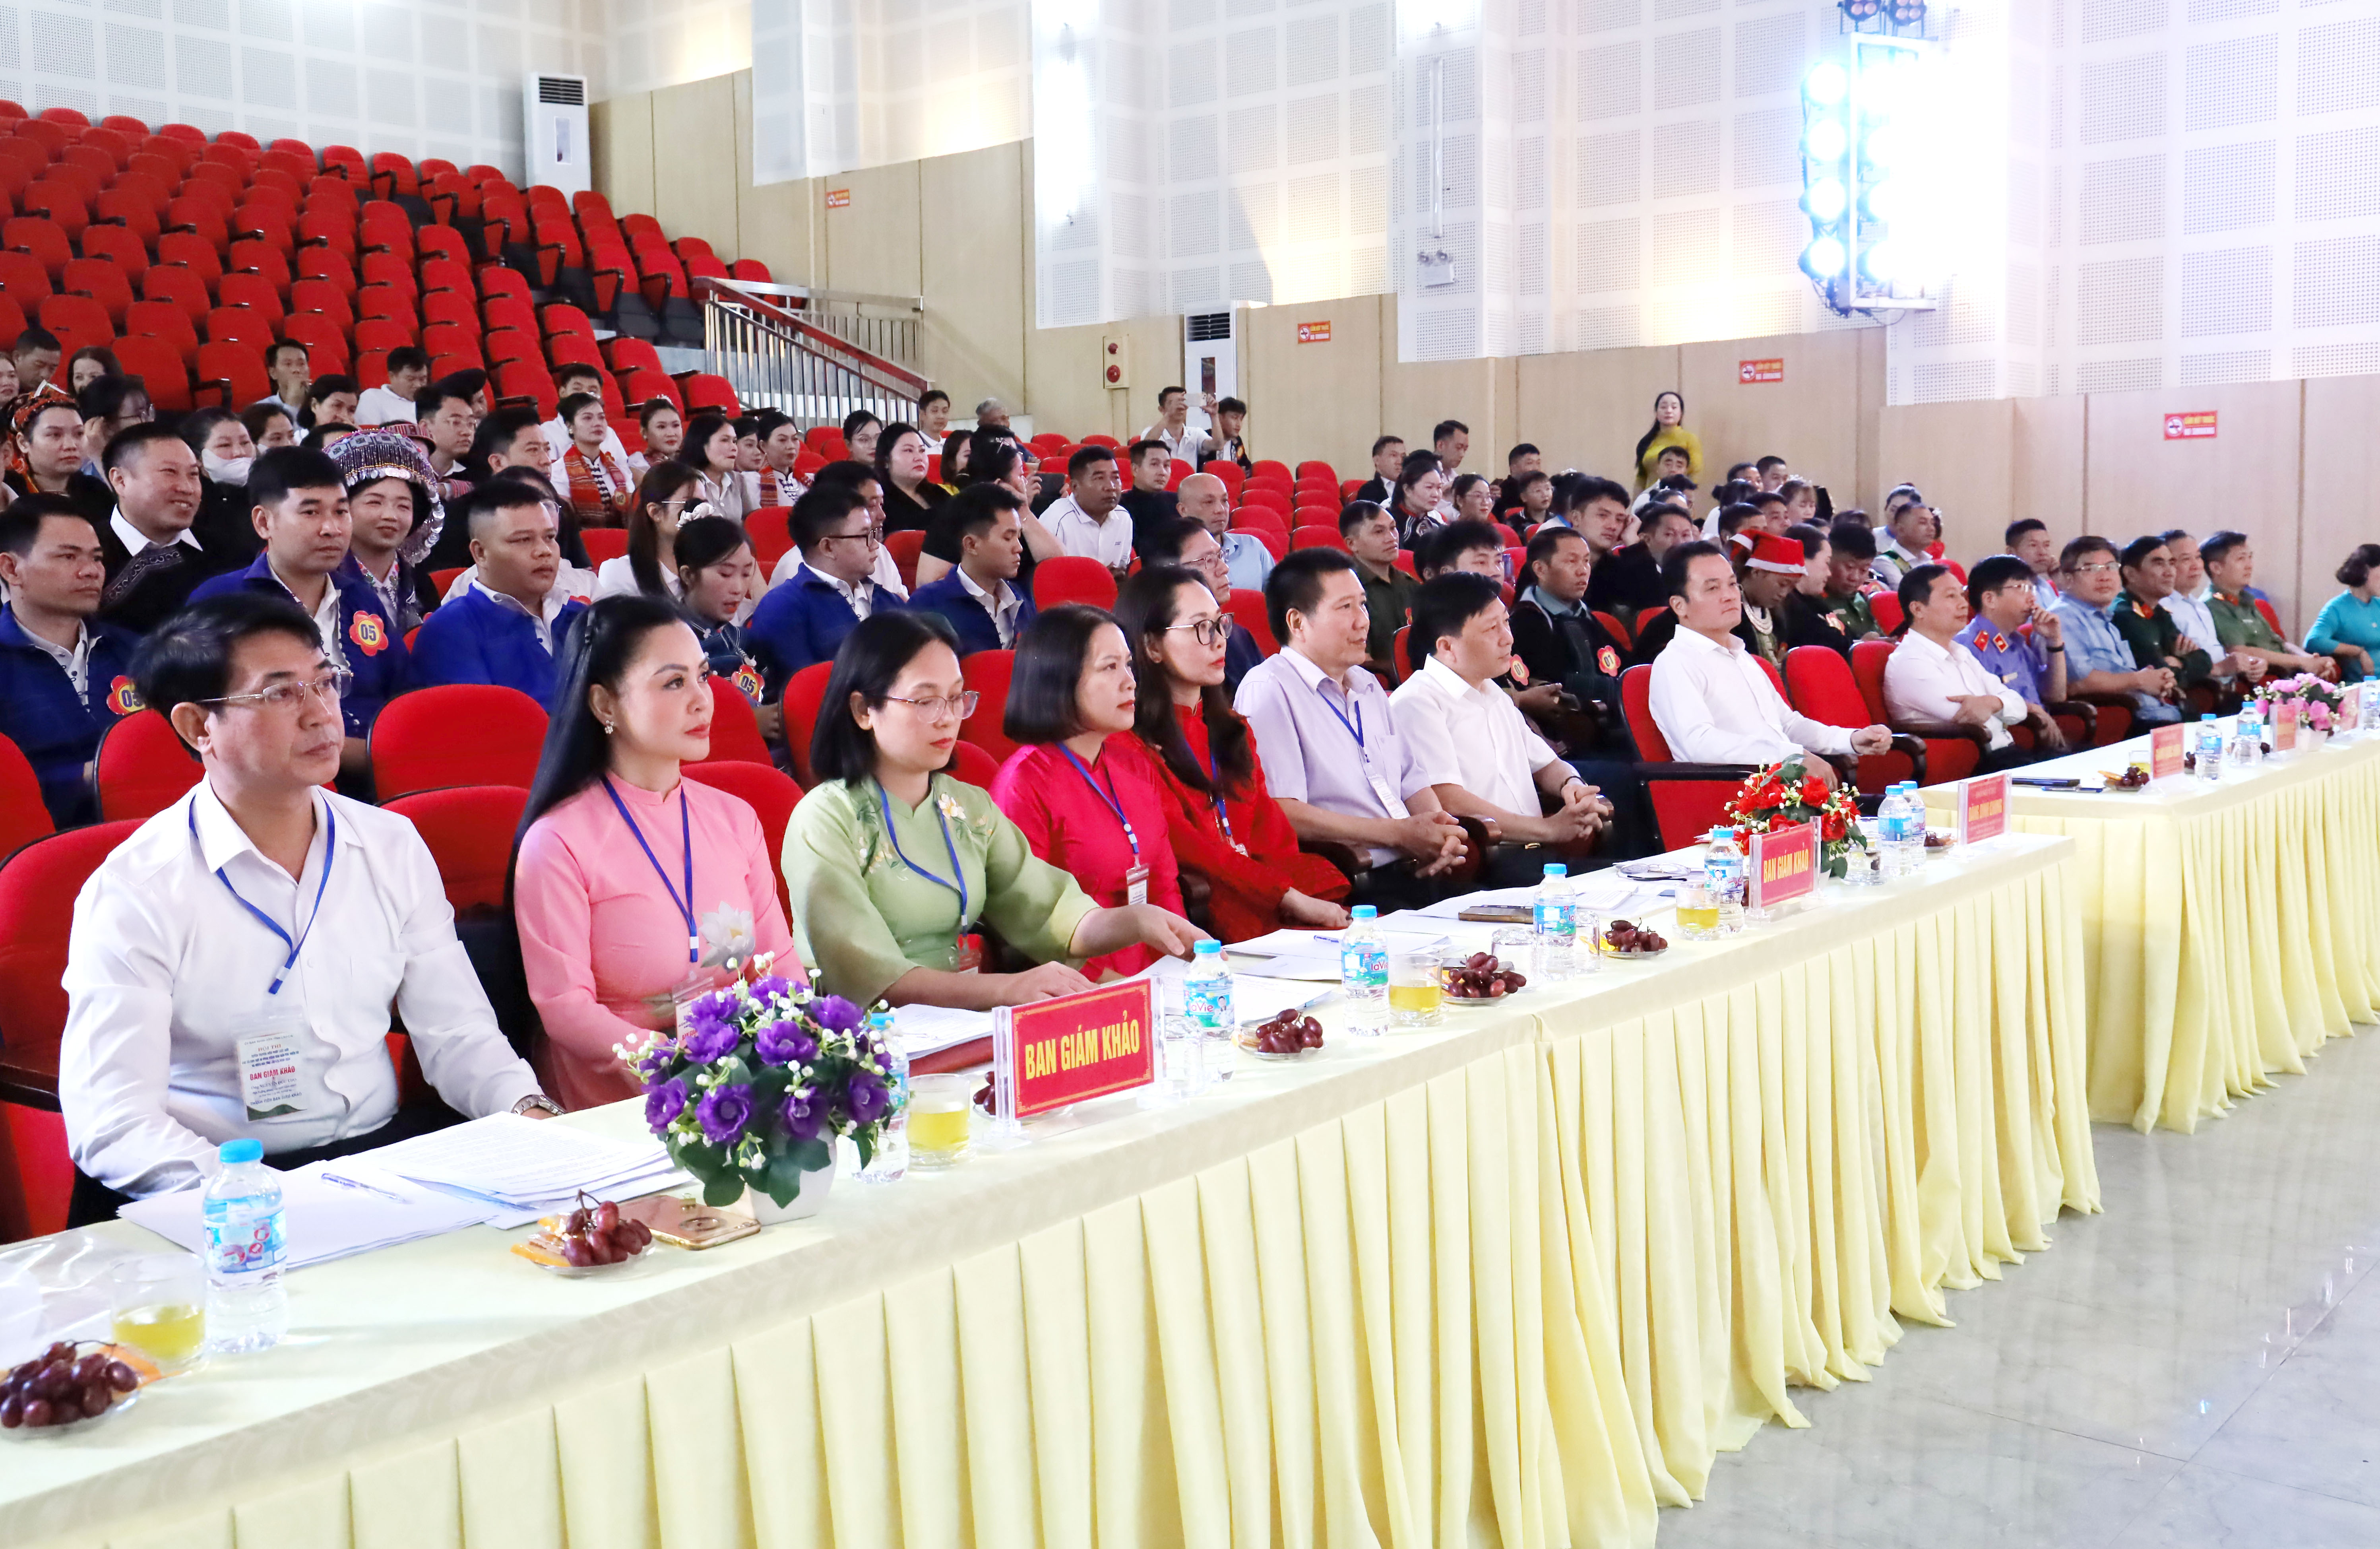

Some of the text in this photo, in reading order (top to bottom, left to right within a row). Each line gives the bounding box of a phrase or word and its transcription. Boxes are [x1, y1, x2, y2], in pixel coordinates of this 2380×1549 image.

[360, 624, 376, 641] 05
[1604, 654, 1614, 667] 01
[1514, 663, 1523, 676] 01
[740, 675, 756, 693] 05
[1764, 858, 1776, 883] BAN
[1189, 1002, 1213, 1012] laVie
[1025, 1009, 1140, 1080] BAN GIÁM KHẢO
